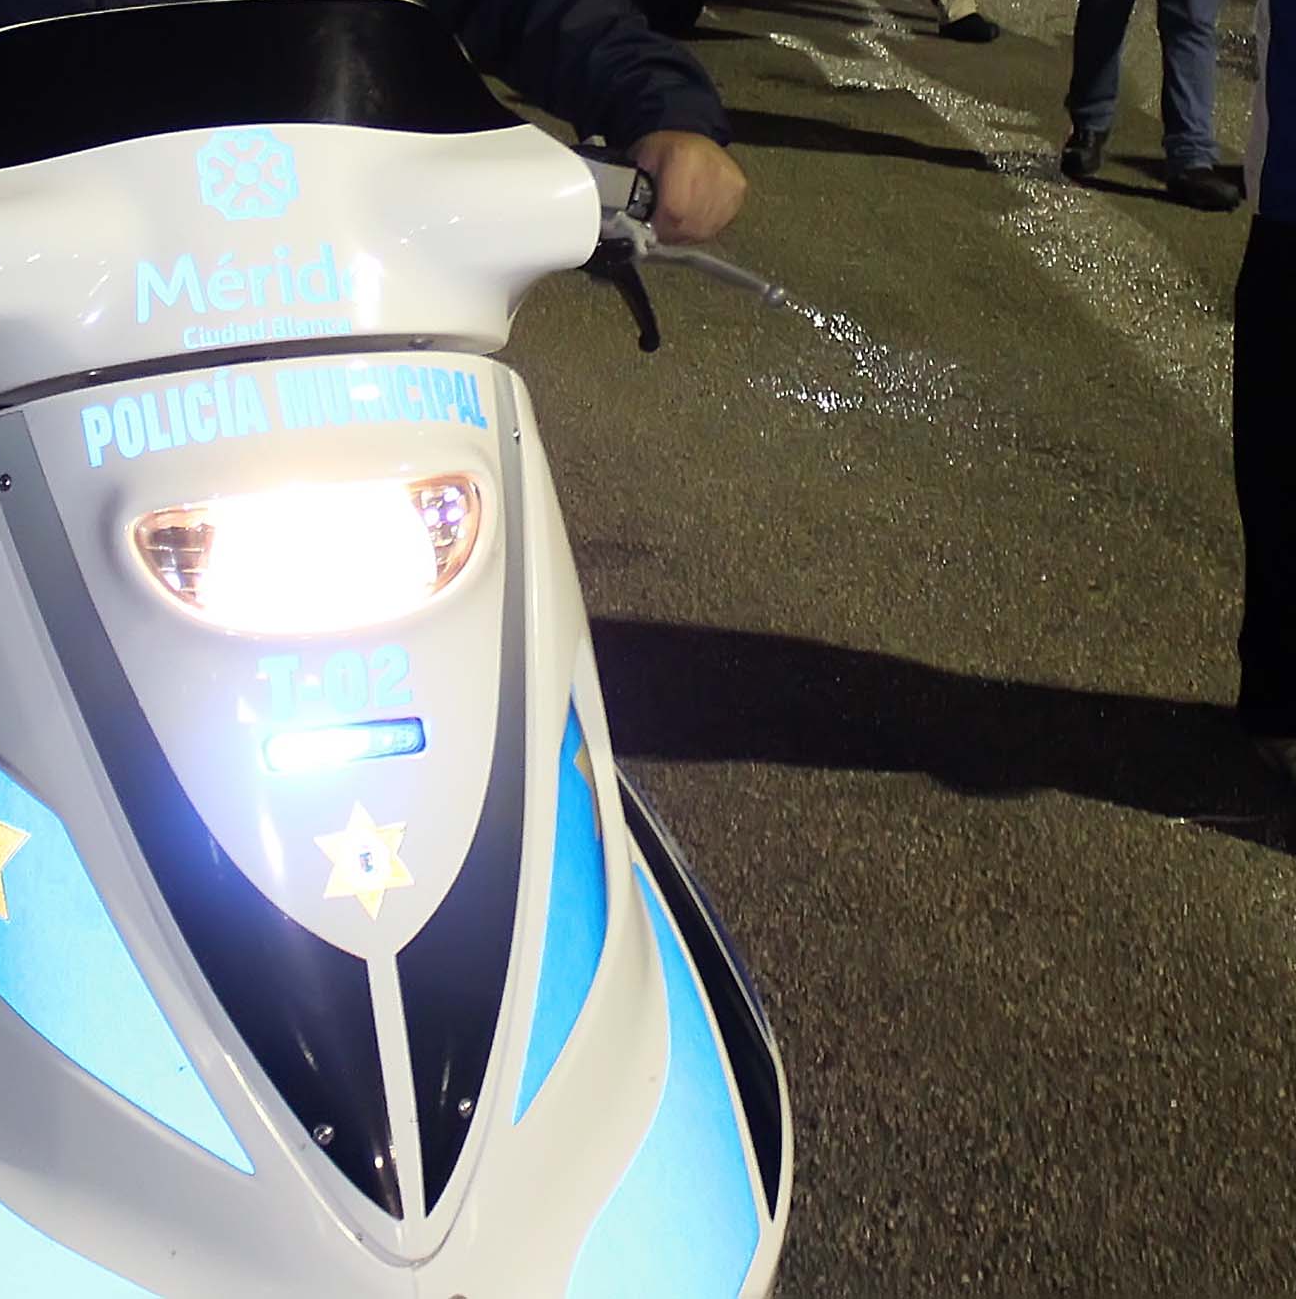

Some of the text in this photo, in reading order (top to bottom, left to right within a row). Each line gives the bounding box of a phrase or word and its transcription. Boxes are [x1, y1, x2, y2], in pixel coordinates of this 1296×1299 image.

[182, 316, 353, 350] Ciudad Blanca
[81, 363, 488, 468] POLICÍA MUNICIPAL
[259, 645, 413, 719] T-02
